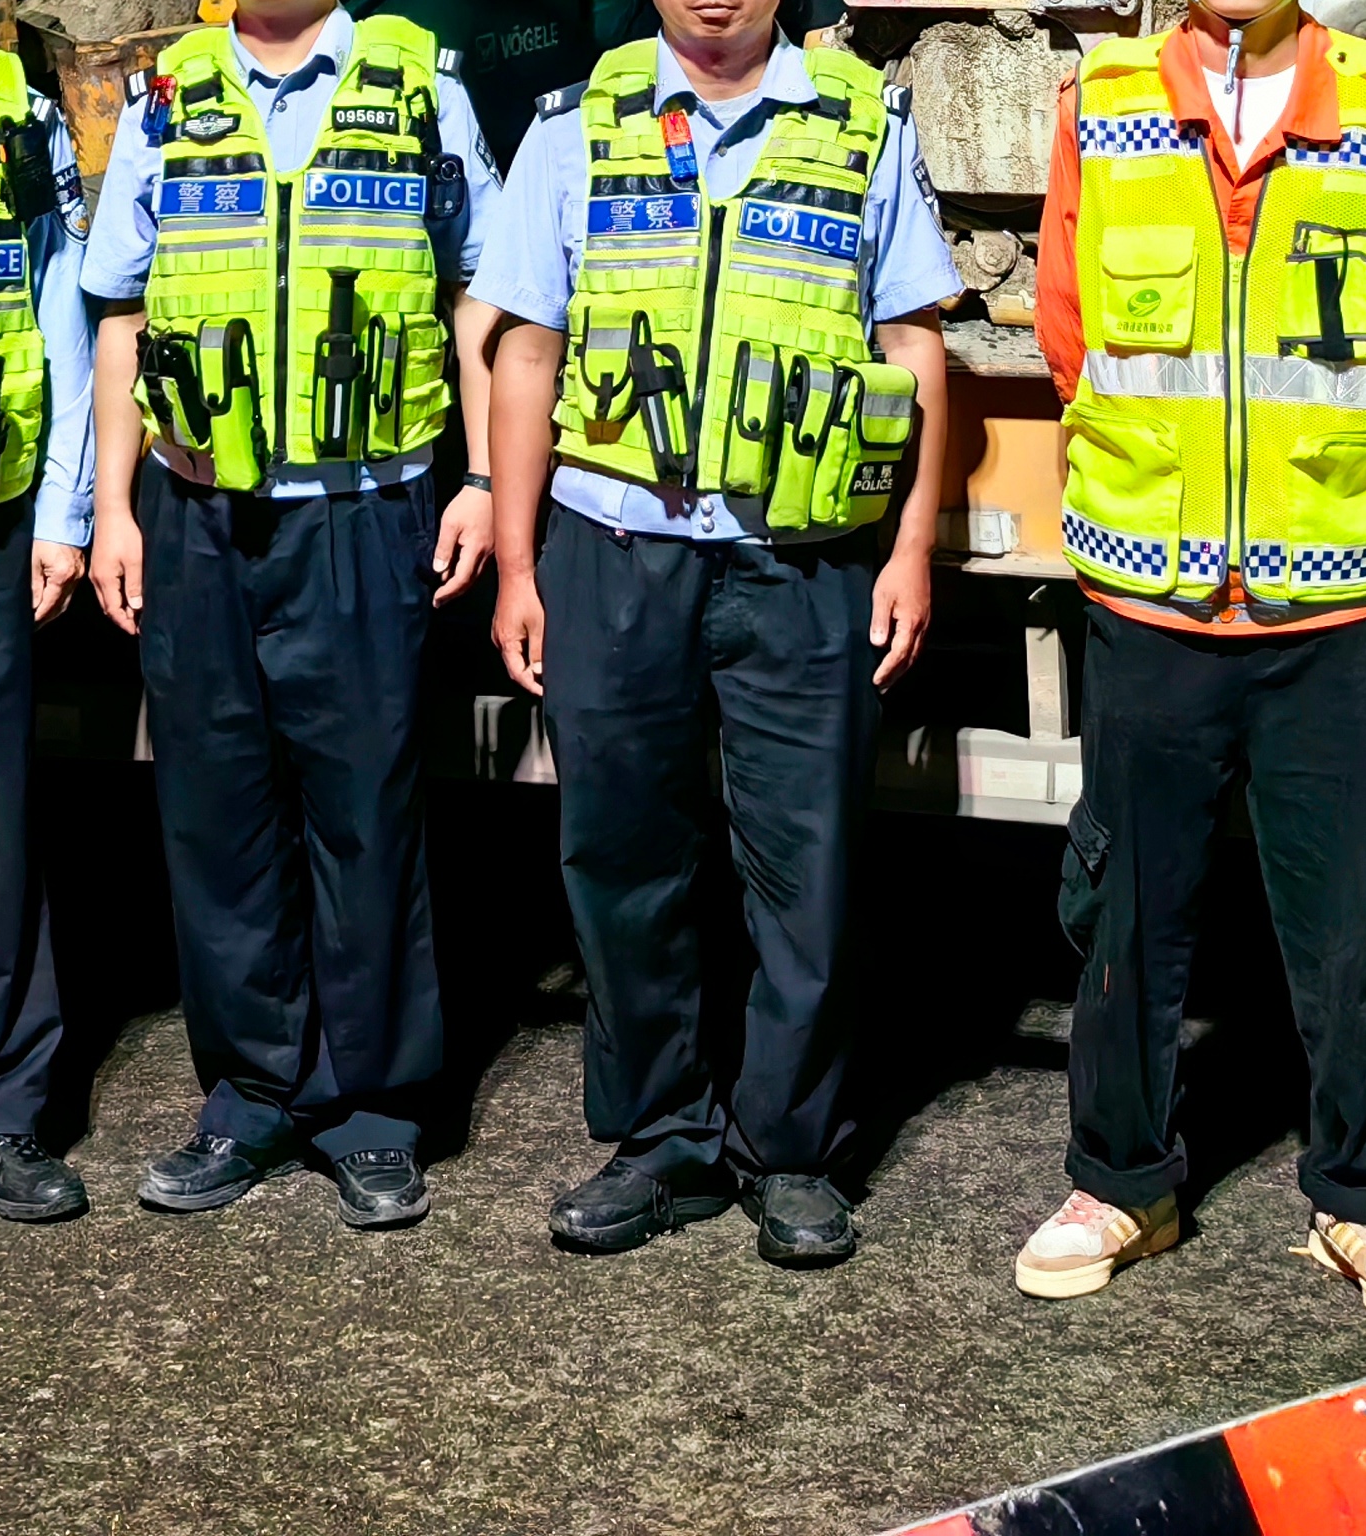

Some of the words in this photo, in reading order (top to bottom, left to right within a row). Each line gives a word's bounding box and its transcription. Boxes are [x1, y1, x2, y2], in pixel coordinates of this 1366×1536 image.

[499, 22, 560, 60] VÖGELE
[336, 109, 395, 125] 095687
[178, 181, 241, 213] 警察
[308, 175, 421, 207] POLICE
[608, 198, 674, 231] 警察
[744, 208, 857, 253] POLICE
[853, 477, 894, 492] POLICE
